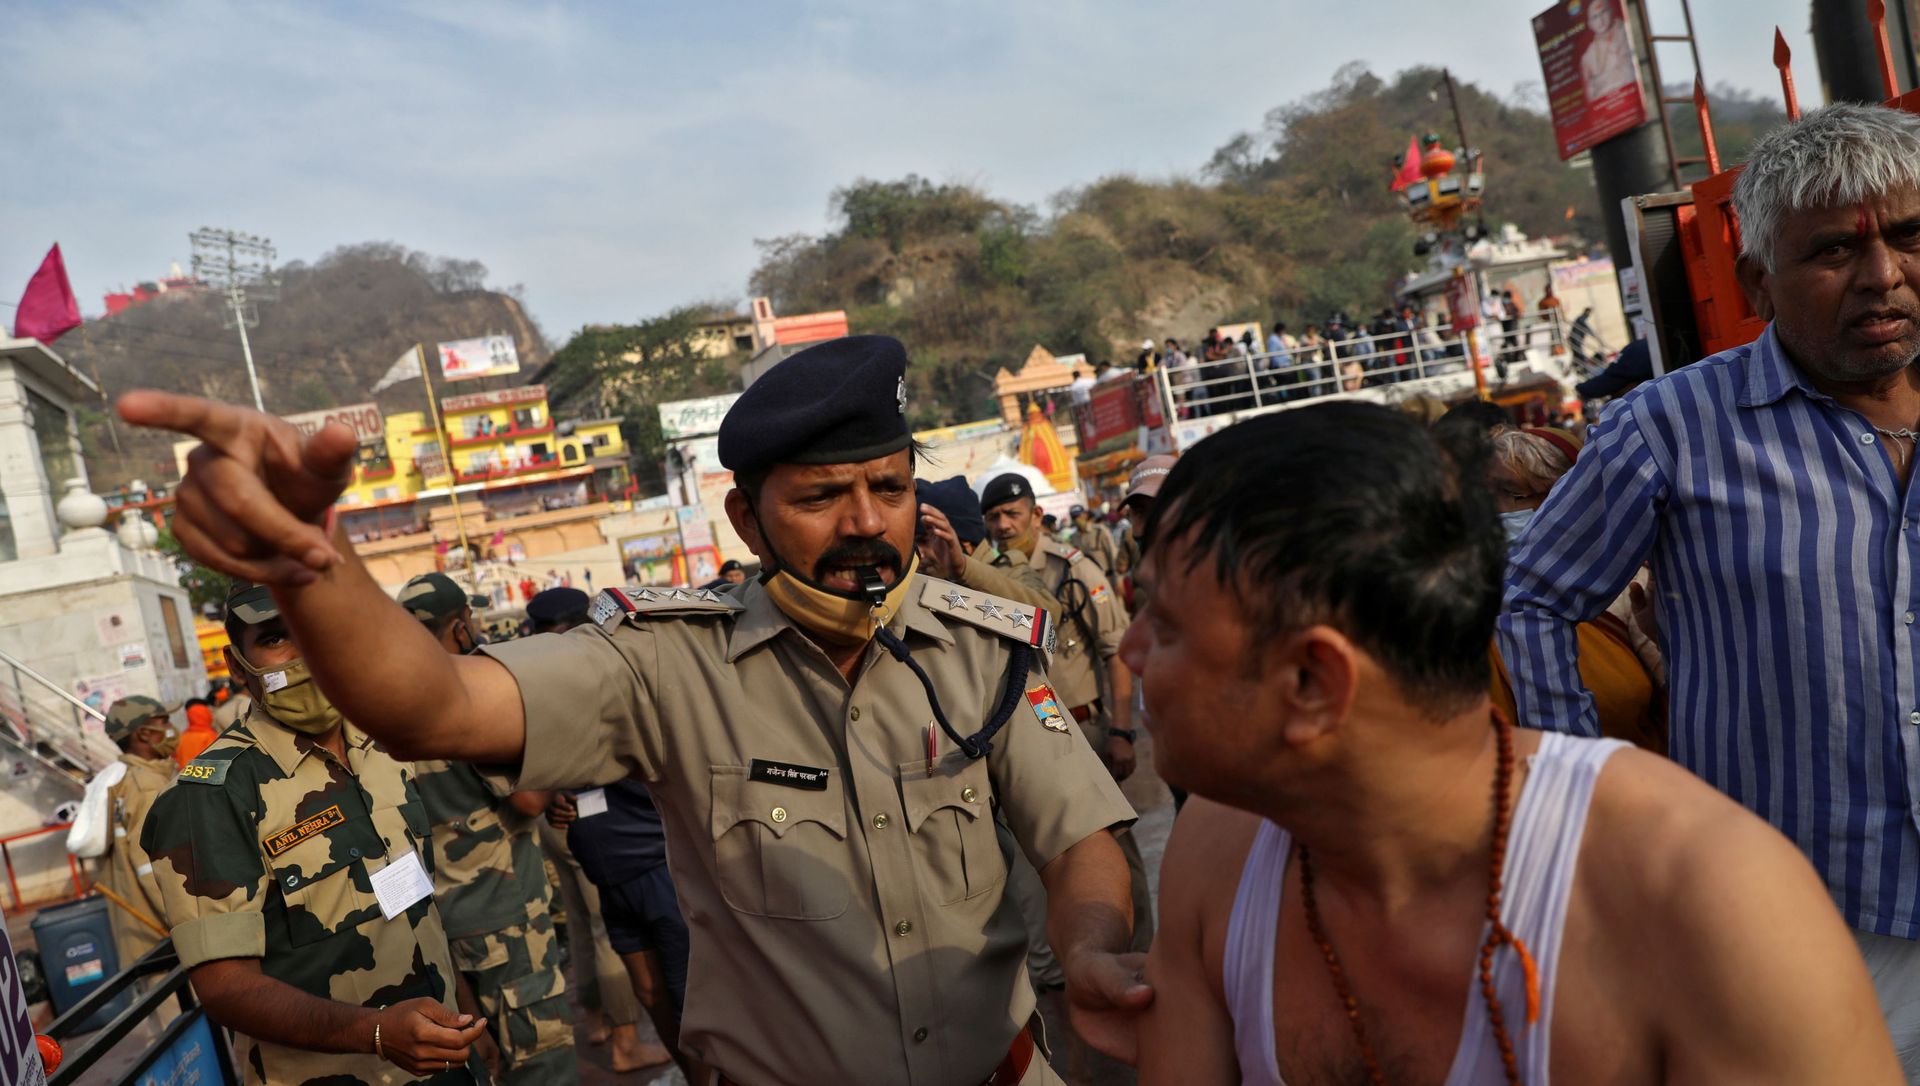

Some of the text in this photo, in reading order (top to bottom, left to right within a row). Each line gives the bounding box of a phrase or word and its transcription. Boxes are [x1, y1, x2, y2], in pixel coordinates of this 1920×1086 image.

[180, 764, 216, 779] BSF
[787, 768, 799, 779] सिंह
[274, 832, 298, 849] ANIL
[296, 816, 331, 837] NEHRA
